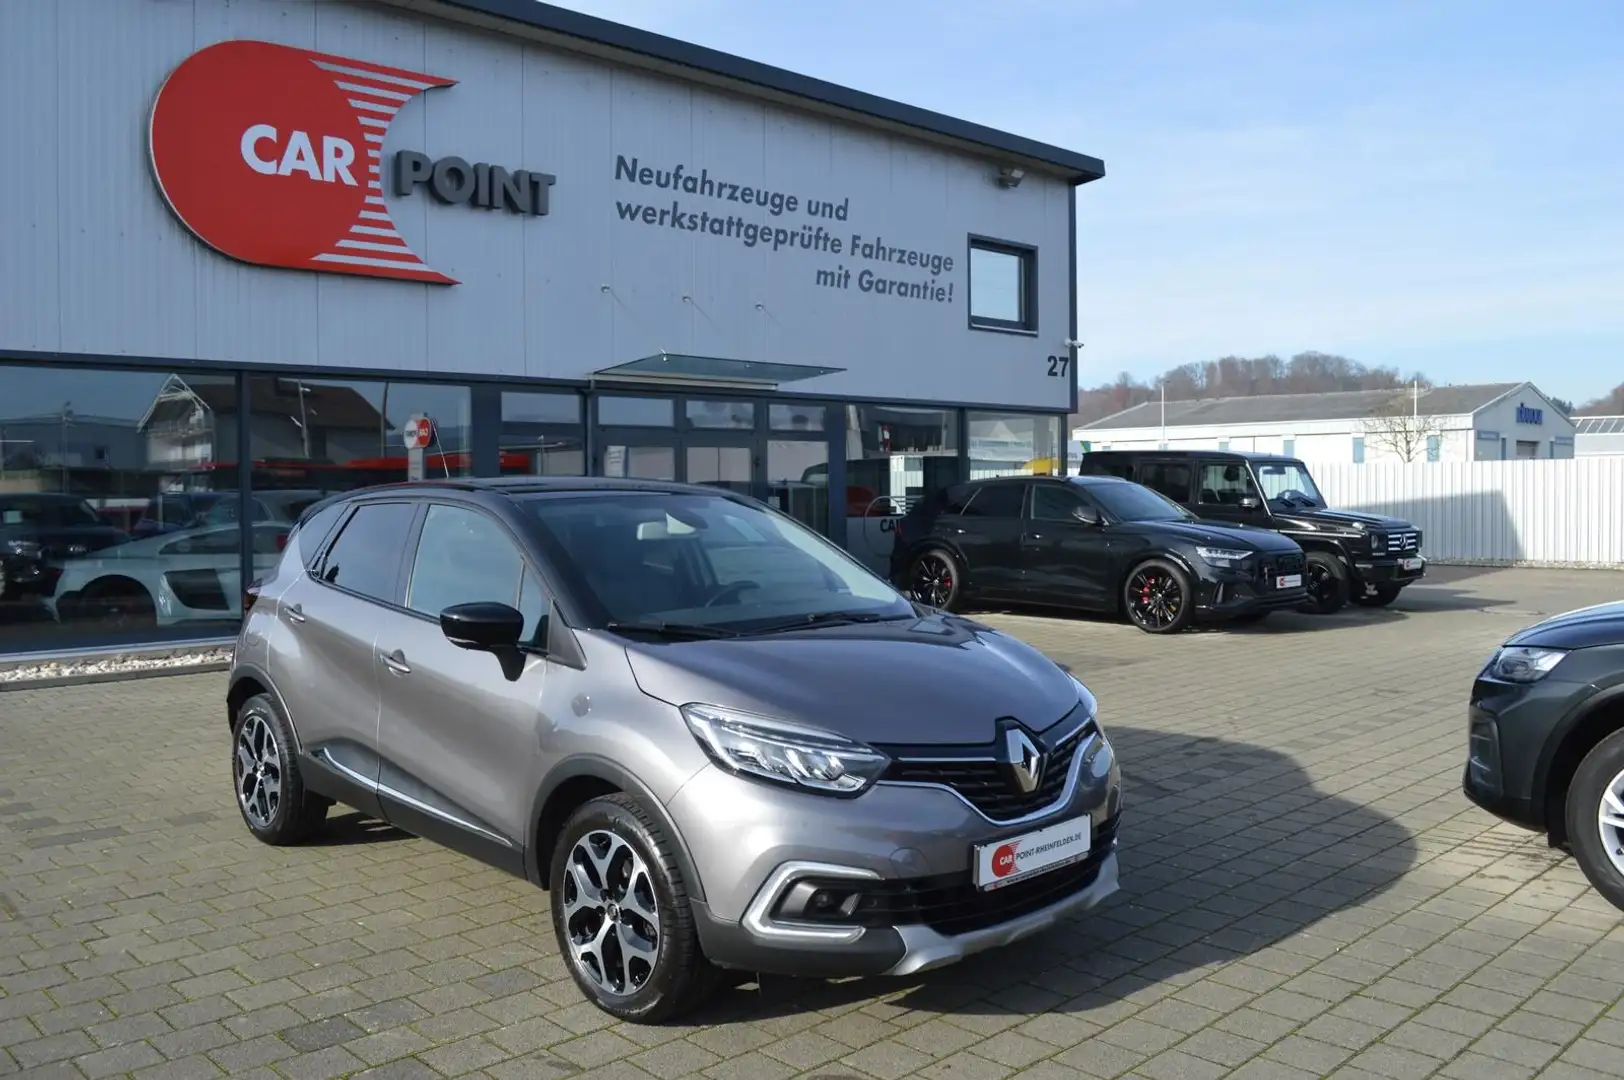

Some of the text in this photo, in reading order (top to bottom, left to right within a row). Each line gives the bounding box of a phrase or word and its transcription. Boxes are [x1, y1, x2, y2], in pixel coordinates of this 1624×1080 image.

[240, 124, 557, 216] CAR POINT
[615, 155, 849, 221] Neufahrzeuge und
[616, 201, 954, 276] werkstattgeprüfte Fahrzeuge
[816, 265, 954, 303] mit Garantie!
[1047, 355, 1069, 378] 27
[880, 518, 899, 533] CA
[999, 855, 1013, 865] CAR
